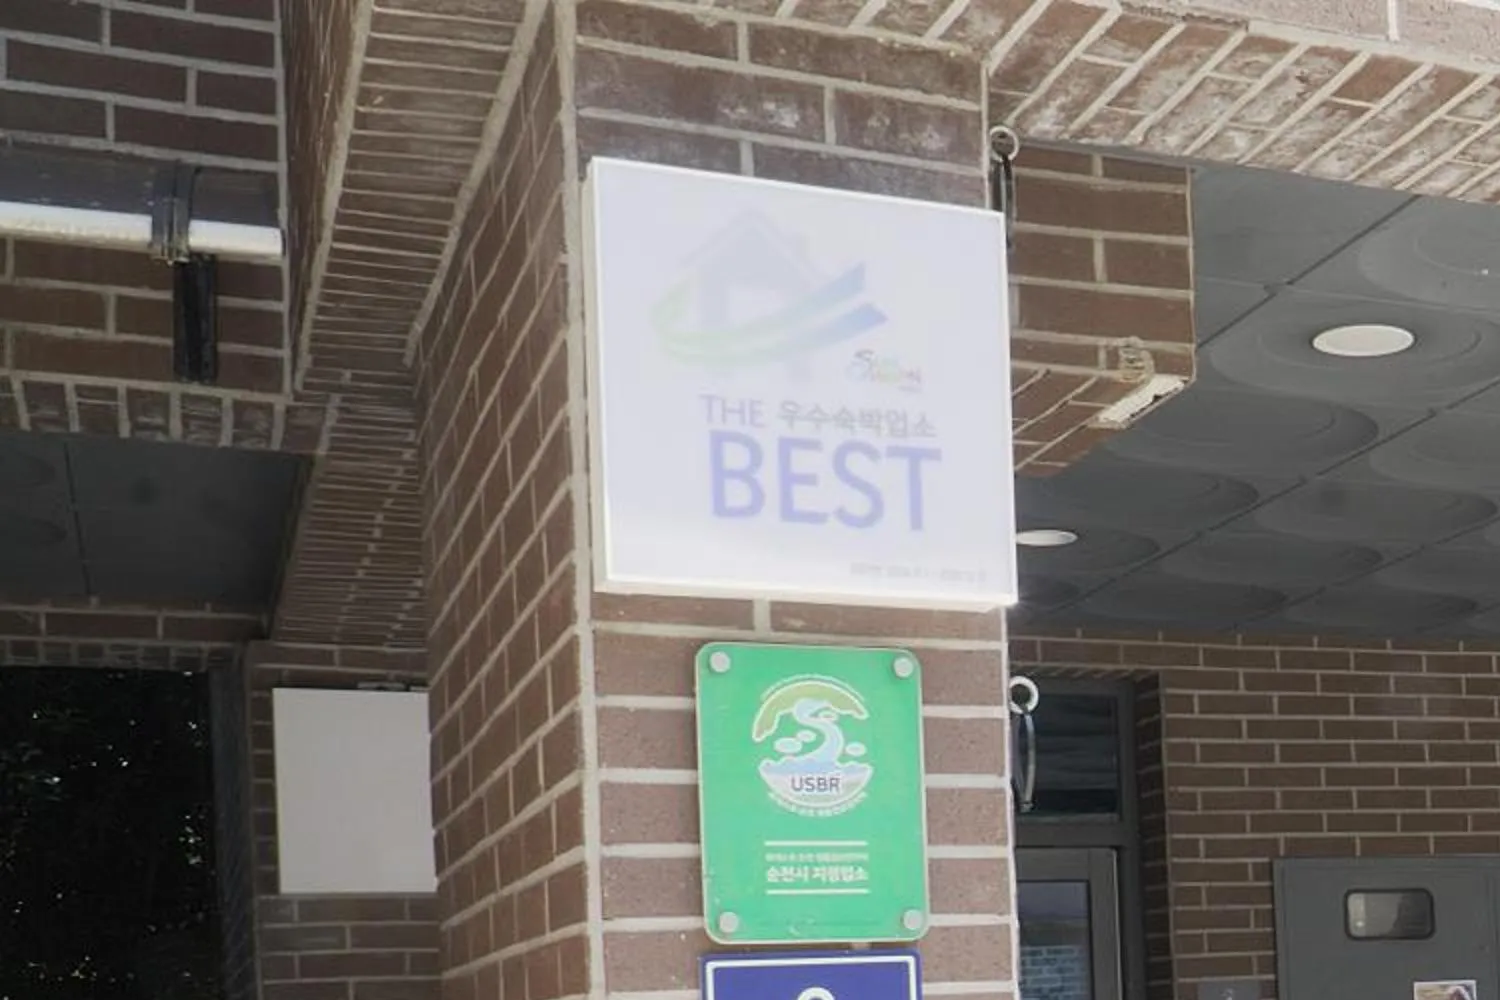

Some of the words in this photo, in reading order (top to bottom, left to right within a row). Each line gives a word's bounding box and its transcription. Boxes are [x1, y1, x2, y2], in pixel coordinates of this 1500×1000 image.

[698, 394, 766, 428] THE
[776, 399, 938, 438] 우수숙박업소
[708, 428, 942, 532] BEST
[791, 775, 841, 793] USBR
